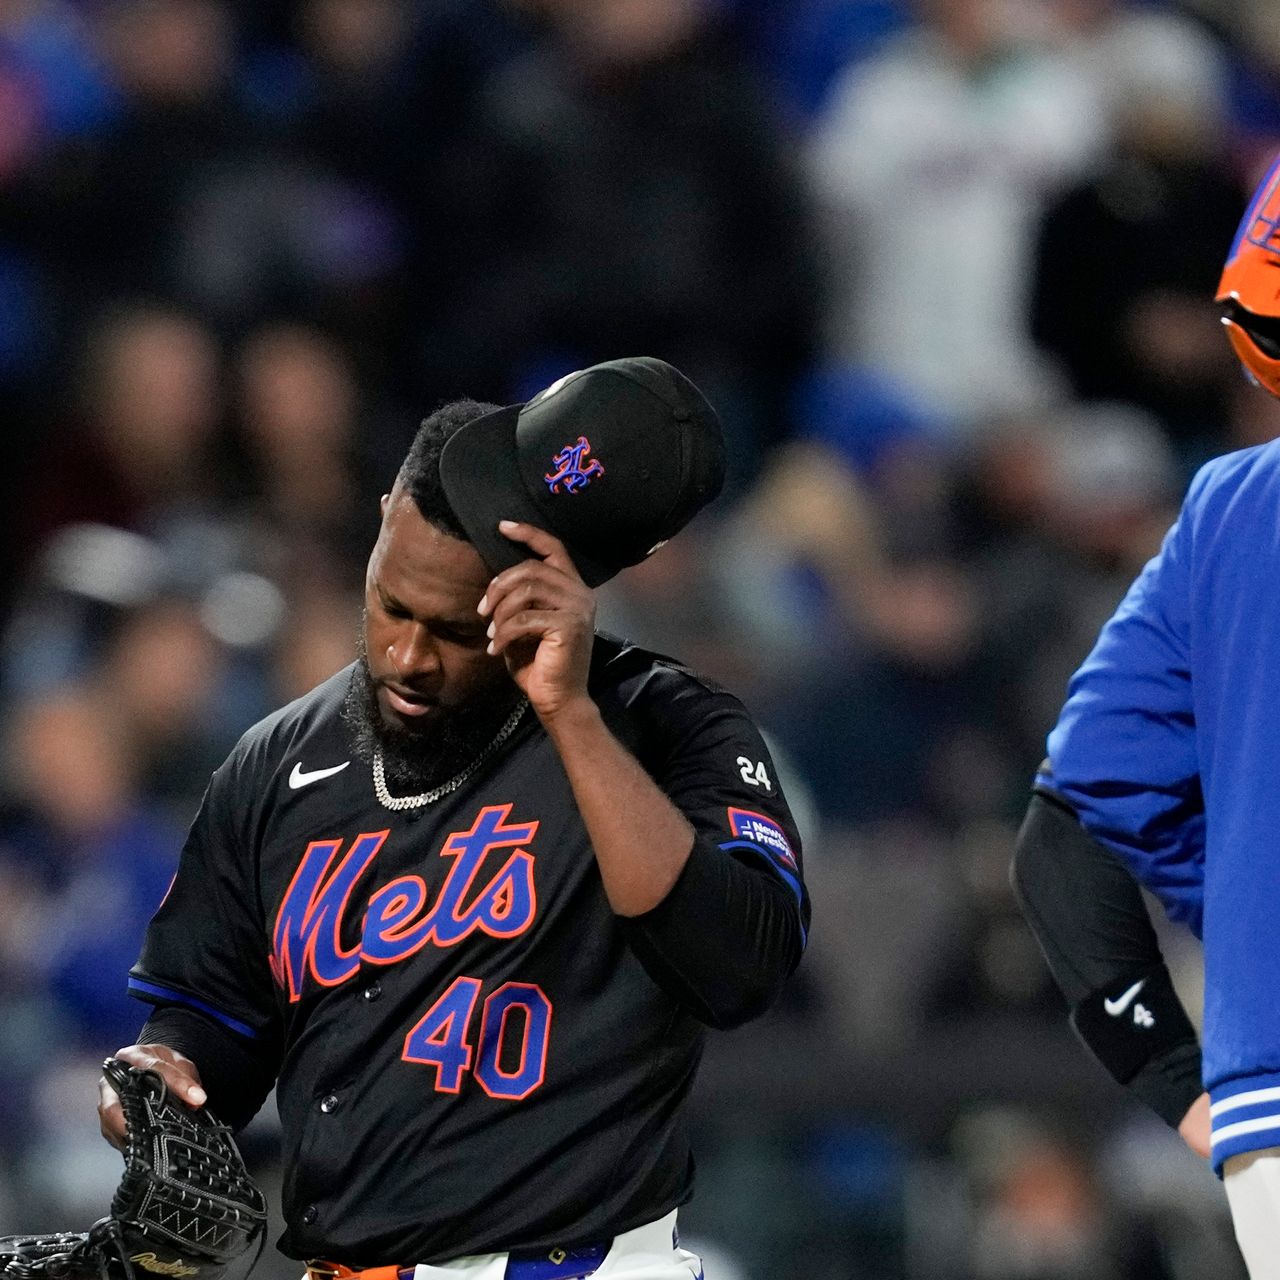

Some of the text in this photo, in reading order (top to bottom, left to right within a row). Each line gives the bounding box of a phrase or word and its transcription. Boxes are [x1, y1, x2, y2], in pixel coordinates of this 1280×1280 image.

[736, 755, 772, 792] 24
[268, 802, 540, 1004] Mets
[400, 975, 554, 1101] 40
